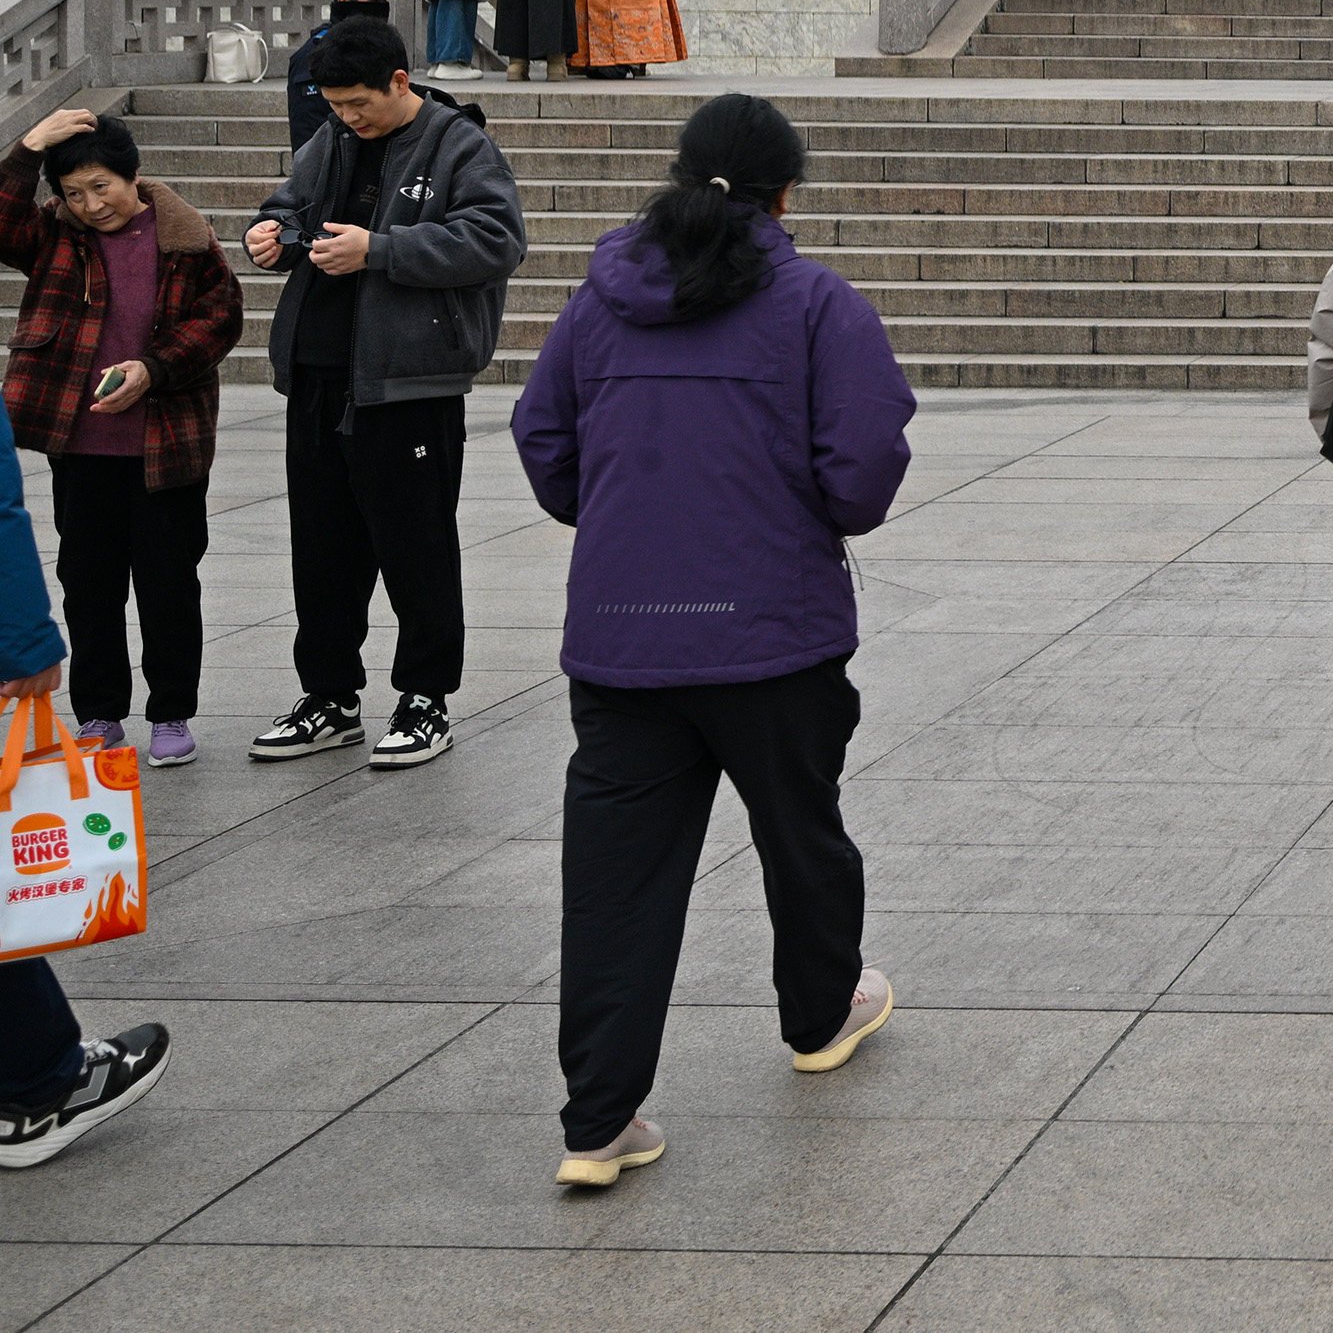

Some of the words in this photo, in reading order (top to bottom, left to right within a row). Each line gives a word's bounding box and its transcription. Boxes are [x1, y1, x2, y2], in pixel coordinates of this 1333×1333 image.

[12, 828, 68, 848] BURGER
[13, 841, 70, 866] KING
[8, 877, 86, 903] 火烤汉堡专家
